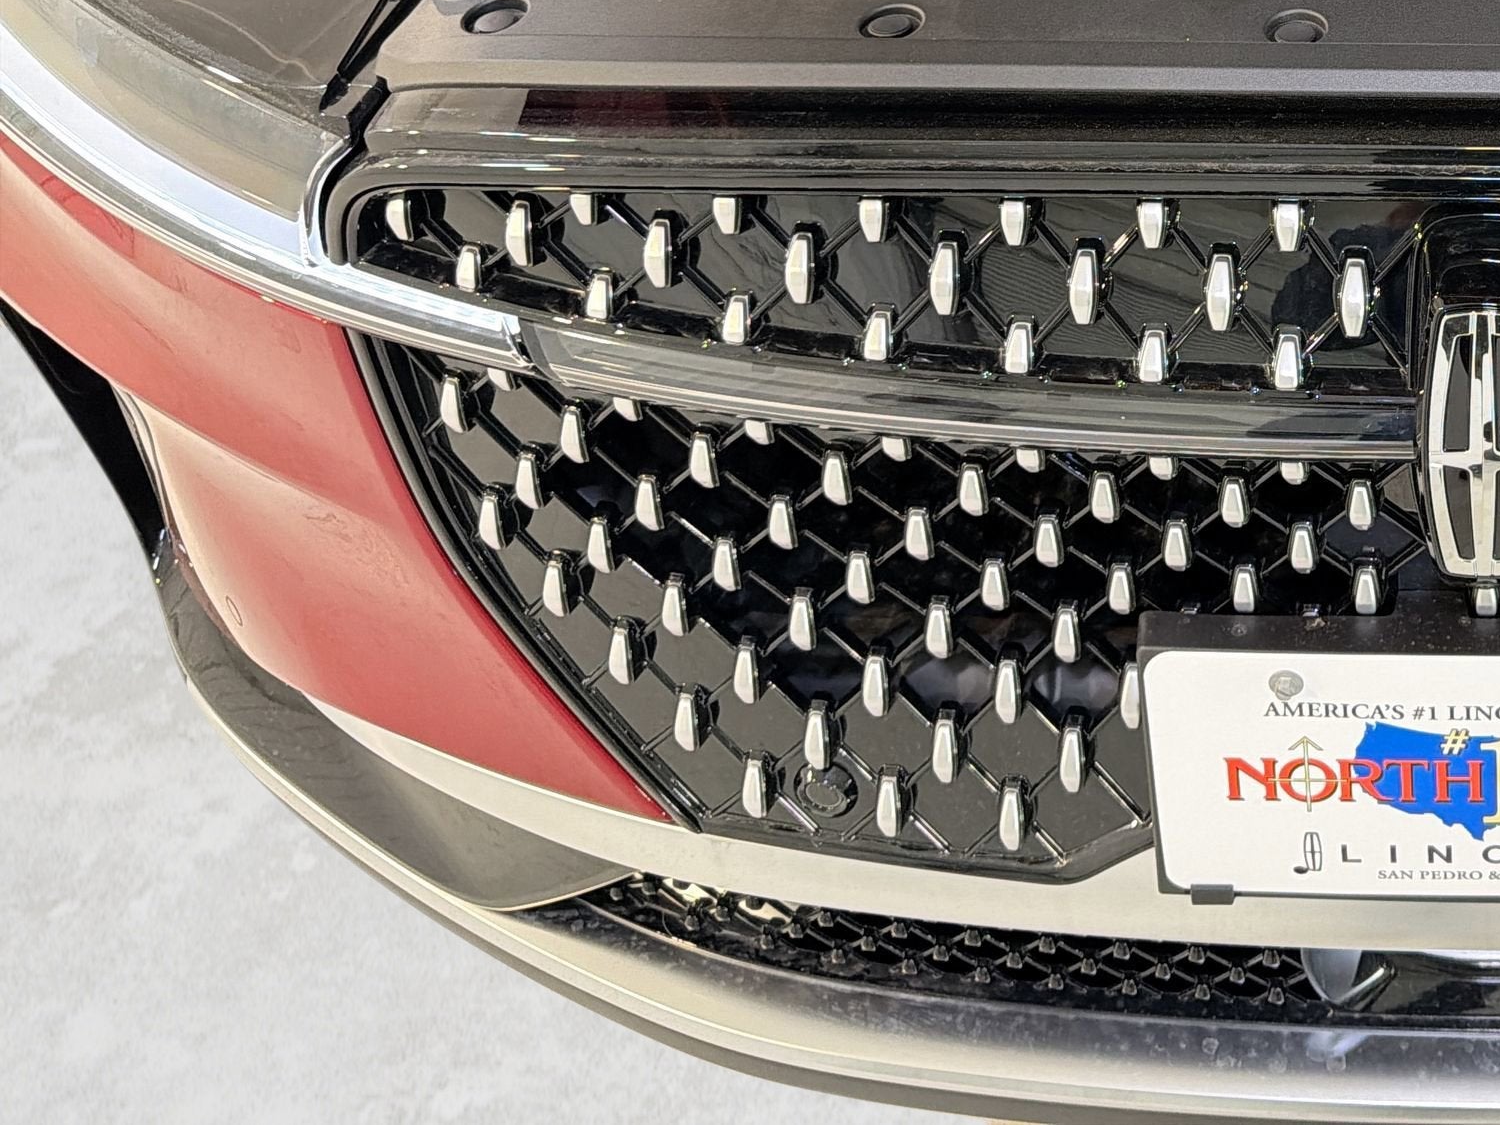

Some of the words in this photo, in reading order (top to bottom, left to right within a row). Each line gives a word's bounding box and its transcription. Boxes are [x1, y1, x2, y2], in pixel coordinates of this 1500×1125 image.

[1263, 701, 1405, 721] AMERICA'S
[1411, 705, 1439, 721] #1
[1223, 757, 1485, 803] NORTH
[1377, 869, 1414, 881] SAN
[1420, 869, 1484, 881] PEDRO
